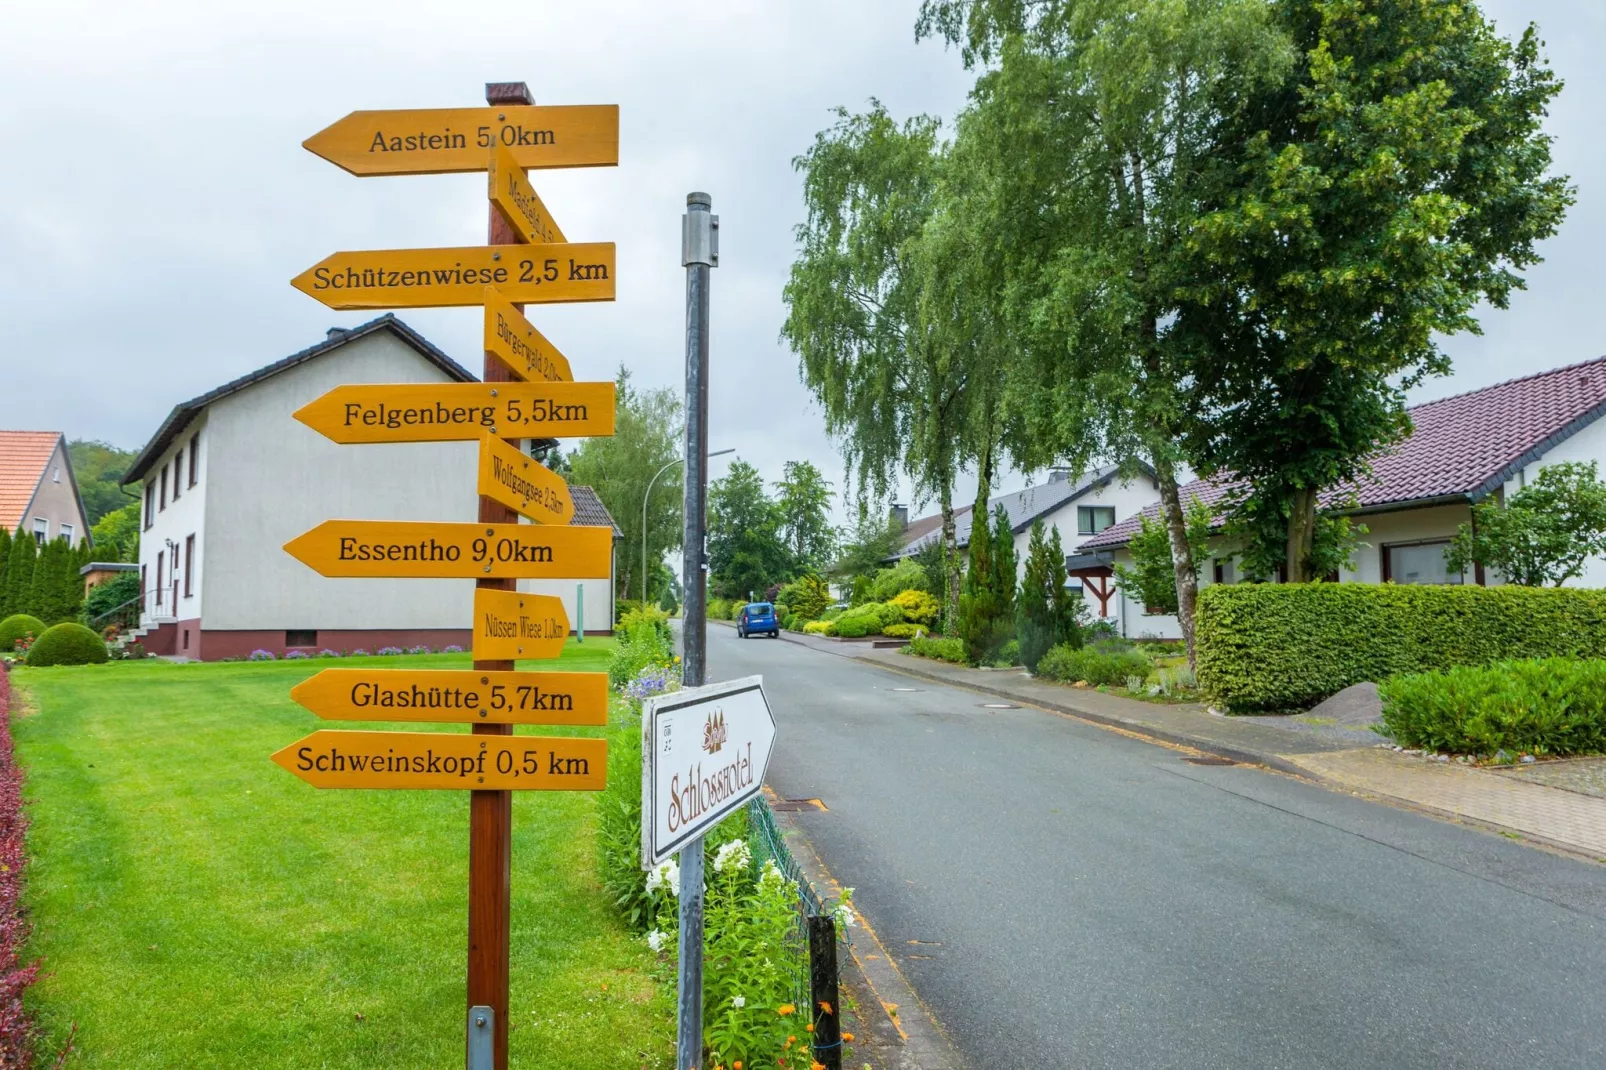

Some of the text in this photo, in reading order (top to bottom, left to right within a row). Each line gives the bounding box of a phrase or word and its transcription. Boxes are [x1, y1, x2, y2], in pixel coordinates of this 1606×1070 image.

[369, 128, 466, 152] Aastein
[508, 173, 541, 234] Madfeld
[313, 258, 608, 290] Schützenwiese 2,5 km
[497, 312, 543, 373] Bürgerwald
[344, 399, 588, 428] Felgenberg 5,5km
[492, 455, 564, 516] Wolfgangsee 2,5km
[338, 537, 553, 566] Essentho 9,0km
[485, 613, 517, 639] Nüssen
[519, 616, 542, 639] Wiese
[351, 682, 573, 711] Glashütte 5,7km
[297, 746, 589, 777] Schweinskopf 0,5 km
